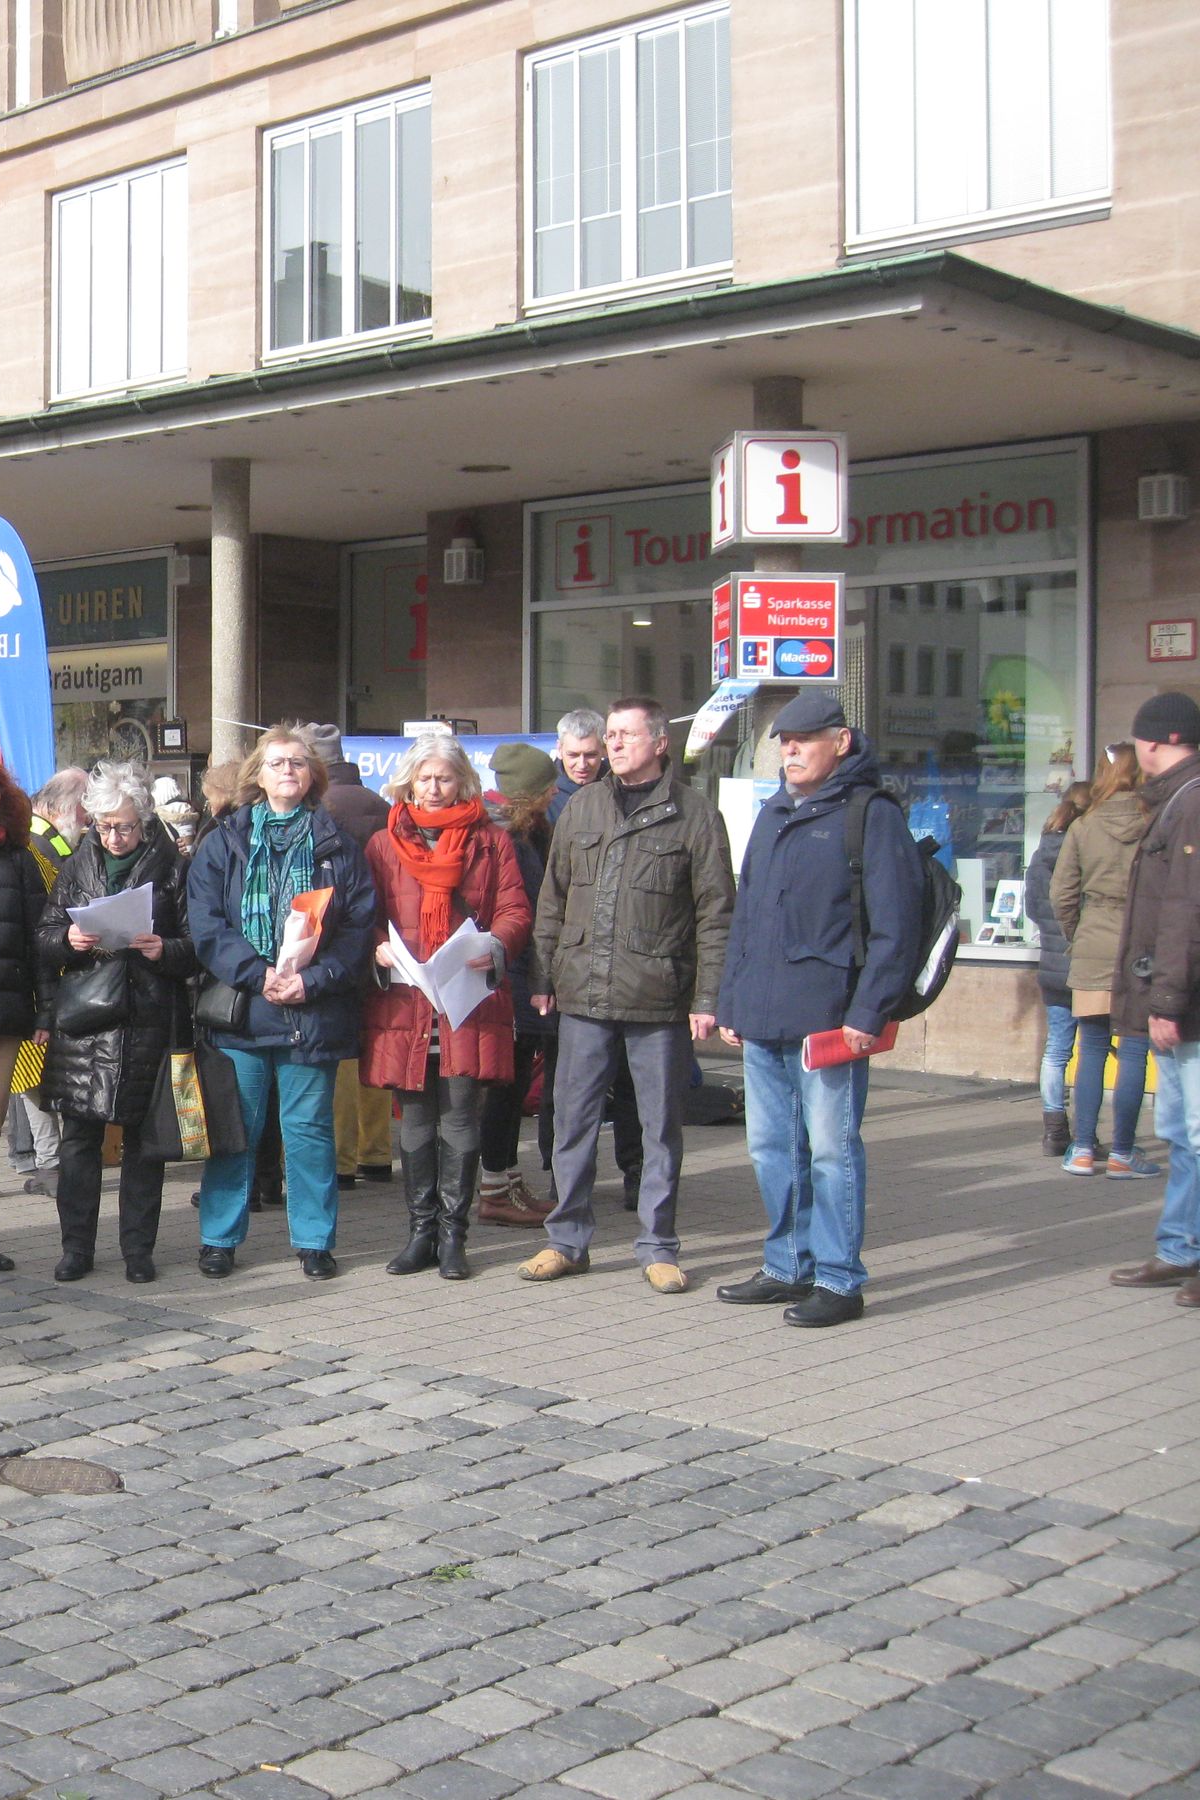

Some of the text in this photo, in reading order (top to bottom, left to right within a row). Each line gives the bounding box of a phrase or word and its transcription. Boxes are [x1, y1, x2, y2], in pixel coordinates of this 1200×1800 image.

[625, 491, 1056, 568] Tour ormation
[58, 586, 143, 627] UHREN
[767, 597, 832, 611] Sparkasse
[767, 614, 828, 629] Nürnberg
[780, 652, 827, 663] Maestro
[47, 662, 142, 694] räutigam
